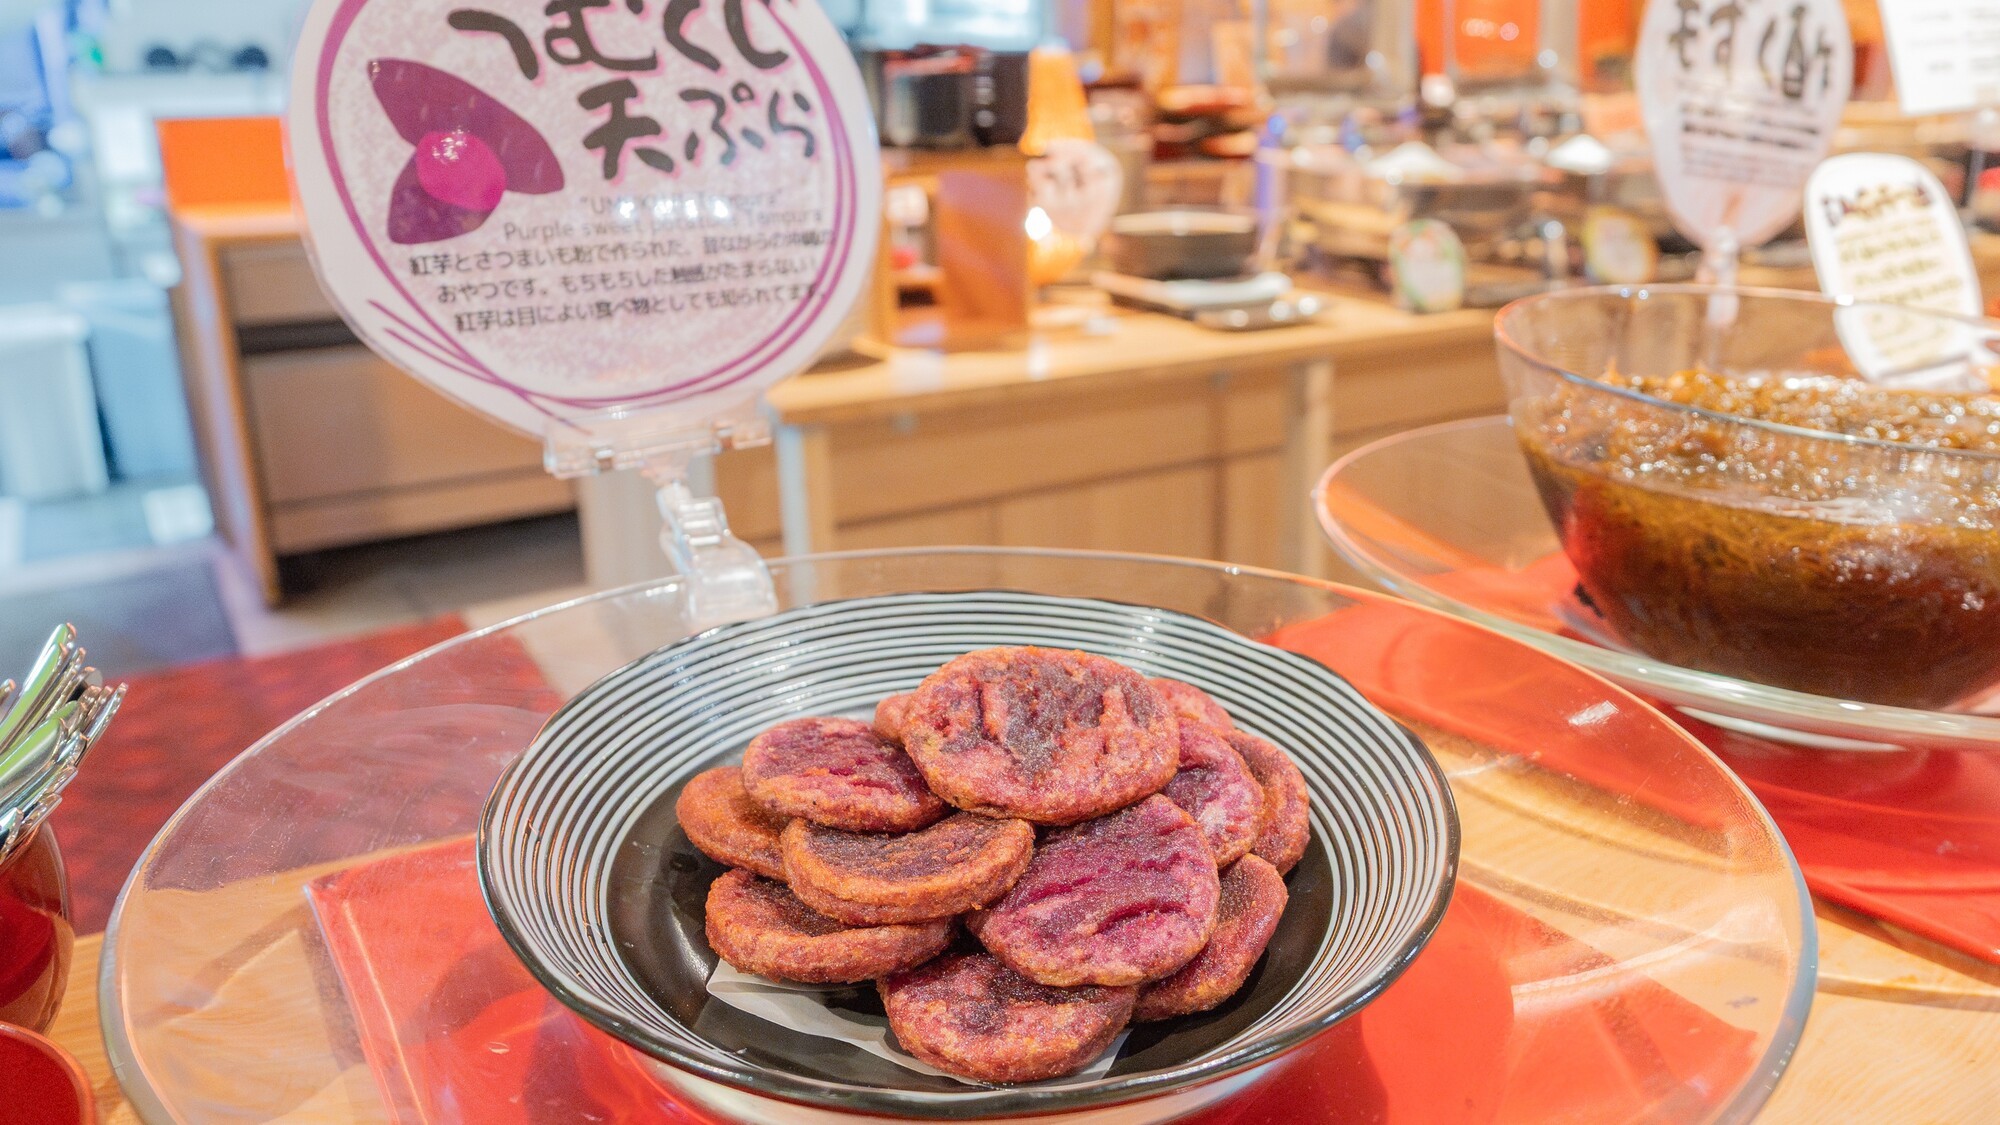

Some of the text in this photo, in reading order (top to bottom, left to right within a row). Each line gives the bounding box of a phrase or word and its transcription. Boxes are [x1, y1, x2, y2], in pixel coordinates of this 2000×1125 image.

[577, 78, 815, 180] 天ぷら
[504, 216, 573, 241] Purple
[583, 215, 643, 236] sweet
